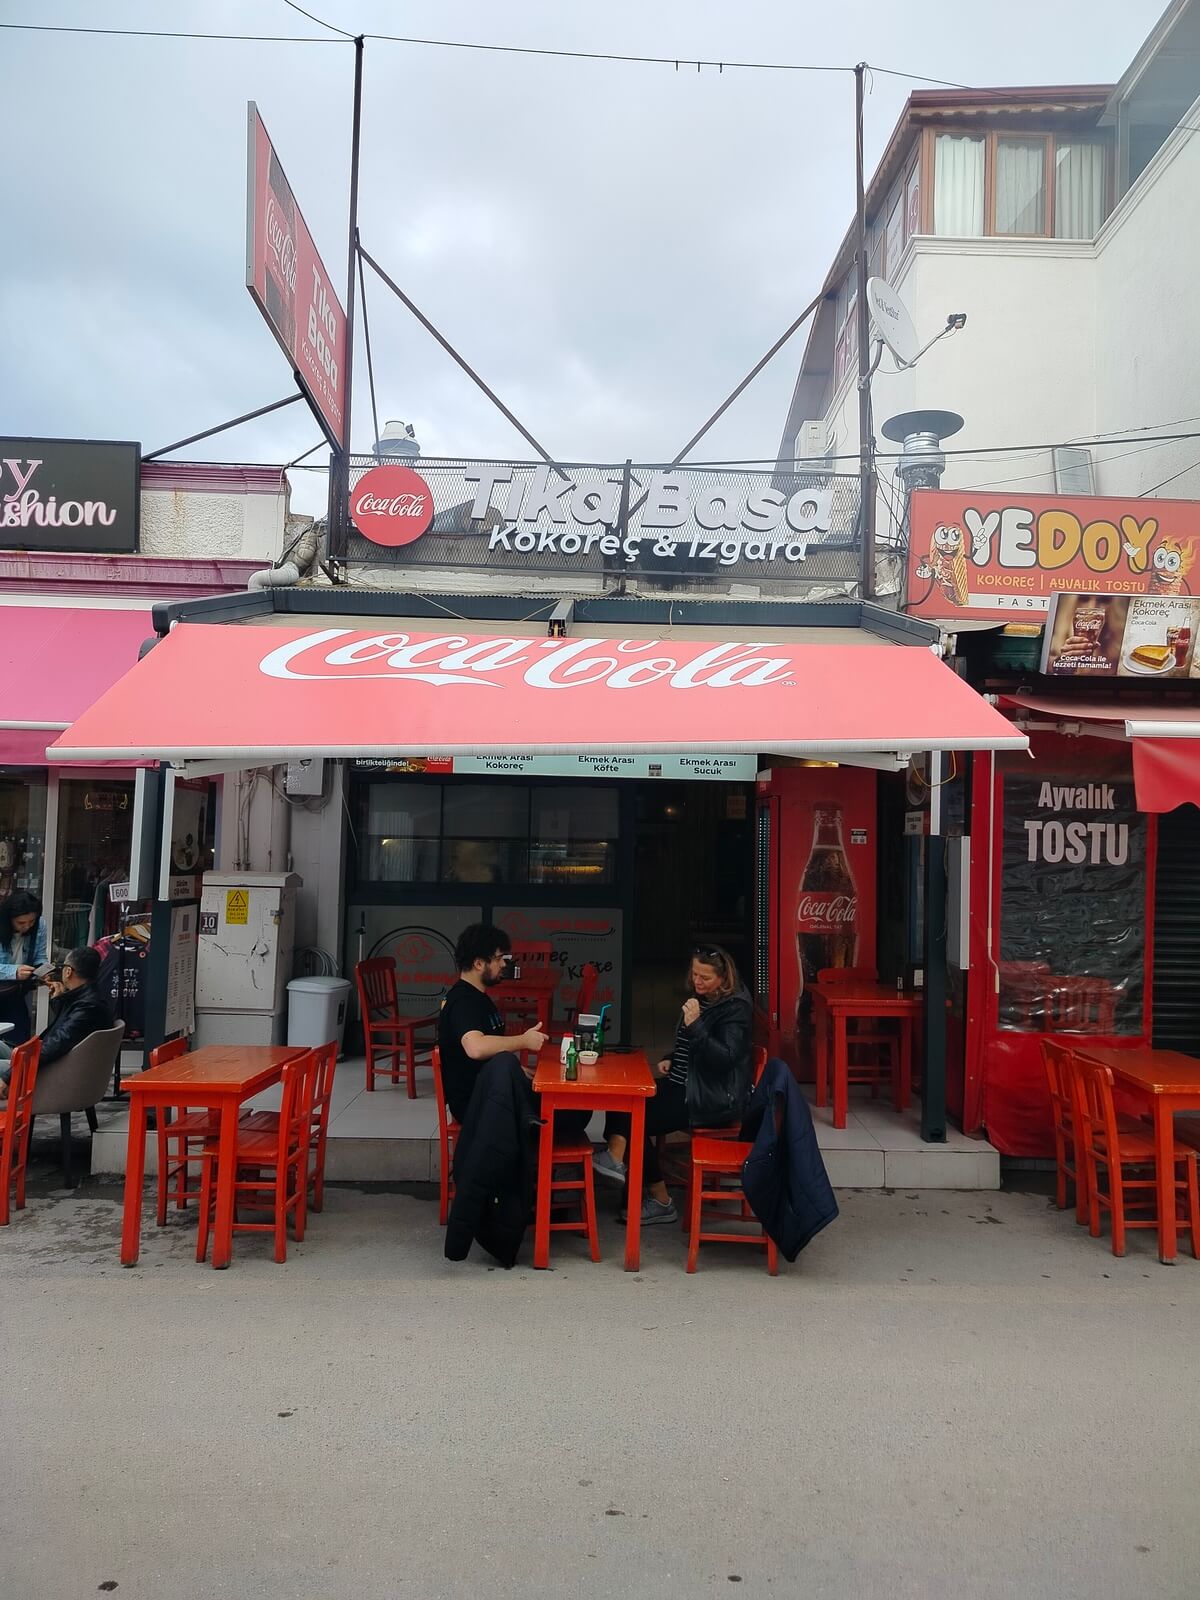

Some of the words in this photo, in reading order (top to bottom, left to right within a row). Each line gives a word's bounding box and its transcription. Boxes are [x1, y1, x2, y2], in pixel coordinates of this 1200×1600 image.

[266, 199, 297, 293] Coca-Cola
[308, 304, 339, 391] Basa
[0, 459, 43, 503] y
[0, 490, 117, 527] shion
[356, 492, 427, 517] Coca-Cola
[641, 473, 835, 532] Basa
[488, 525, 642, 562] Kokoreç
[653, 534, 677, 557] &
[688, 534, 807, 565] Izgara
[963, 507, 1159, 574] YEDOY
[976, 574, 1035, 590] KOKOREÇ
[1049, 577, 1101, 591] AYVALIK
[1106, 581, 1146, 593] TOSTU
[998, 598, 1047, 608] FAST
[1132, 607, 1170, 618] Kokoreç
[1133, 599, 1166, 609] Ekmek
[258, 629, 794, 689] Coca-Cola
[1053, 661, 1077, 669] lezzeti
[1078, 662, 1112, 670] tamamla!
[1060, 655, 1097, 663] Coca-Cola
[486, 761, 524, 771] Kokoreç
[578, 755, 609, 764] Ekmek
[611, 756, 635, 765] Arası
[593, 764, 619, 773] Köfte
[679, 758, 711, 767] Ekmek
[712, 759, 736, 768] Arası
[694, 767, 722, 776] Sucuk
[1038, 782, 1115, 811] Ayvalık
[1024, 821, 1129, 865] TOSTU
[115, 888, 129, 898] 600
[798, 895, 857, 922] Coca-Cola
[203, 916, 215, 929] 10
